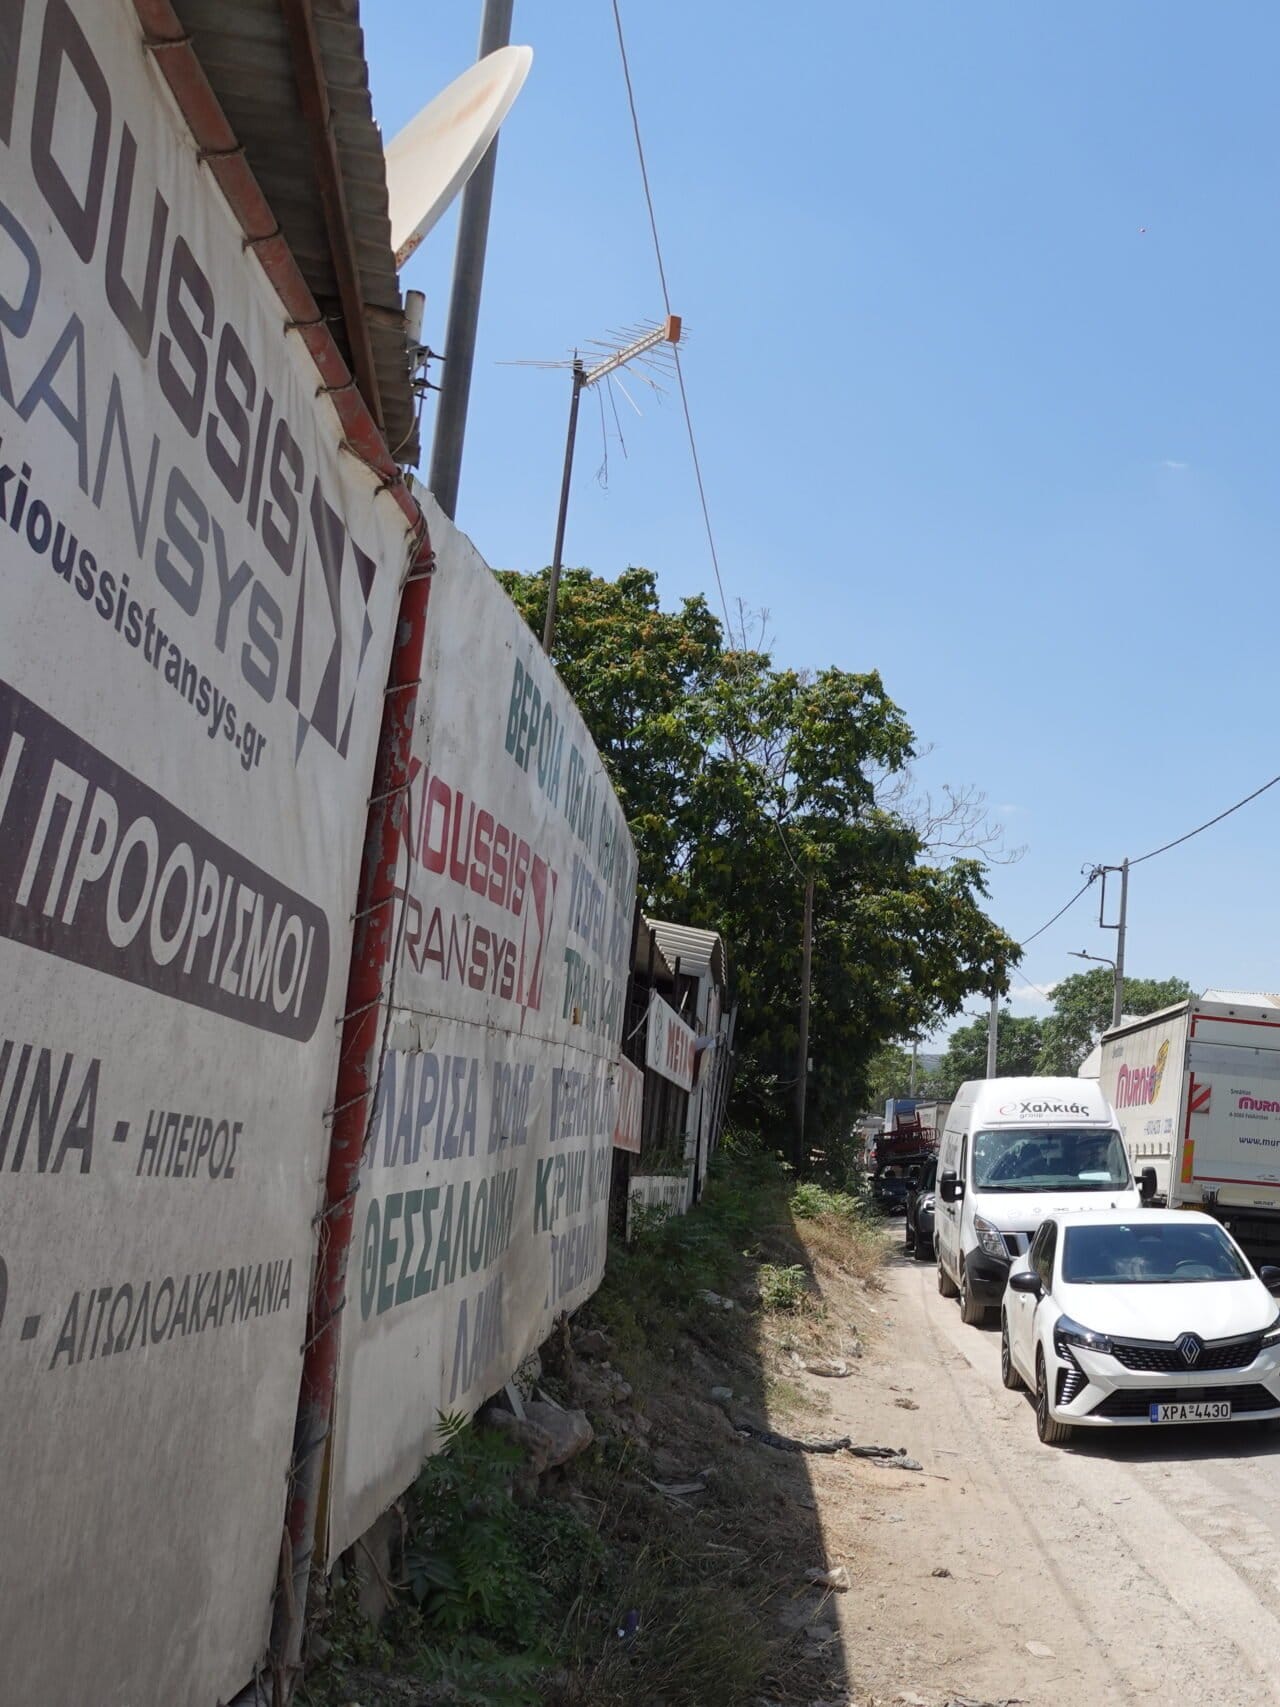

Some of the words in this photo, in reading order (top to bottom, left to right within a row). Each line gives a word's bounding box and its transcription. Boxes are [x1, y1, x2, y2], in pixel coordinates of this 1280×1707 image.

[505, 656, 565, 808] ΒΕΡΟΙΑ
[15, 758, 314, 1018] ΠΡΟΟΡΙΣΜΟΙ
[136, 1110, 243, 1179] ΗΠΕΙΡΟΣ
[368, 1048, 479, 1170] ΛΑΡΙΣΑ
[1020, 1102, 1090, 1117] Χαλκιάς
[49, 1258, 293, 1371] ΑΙΤΩΛΟΑΚΑΡΝΑΝΙΑ
